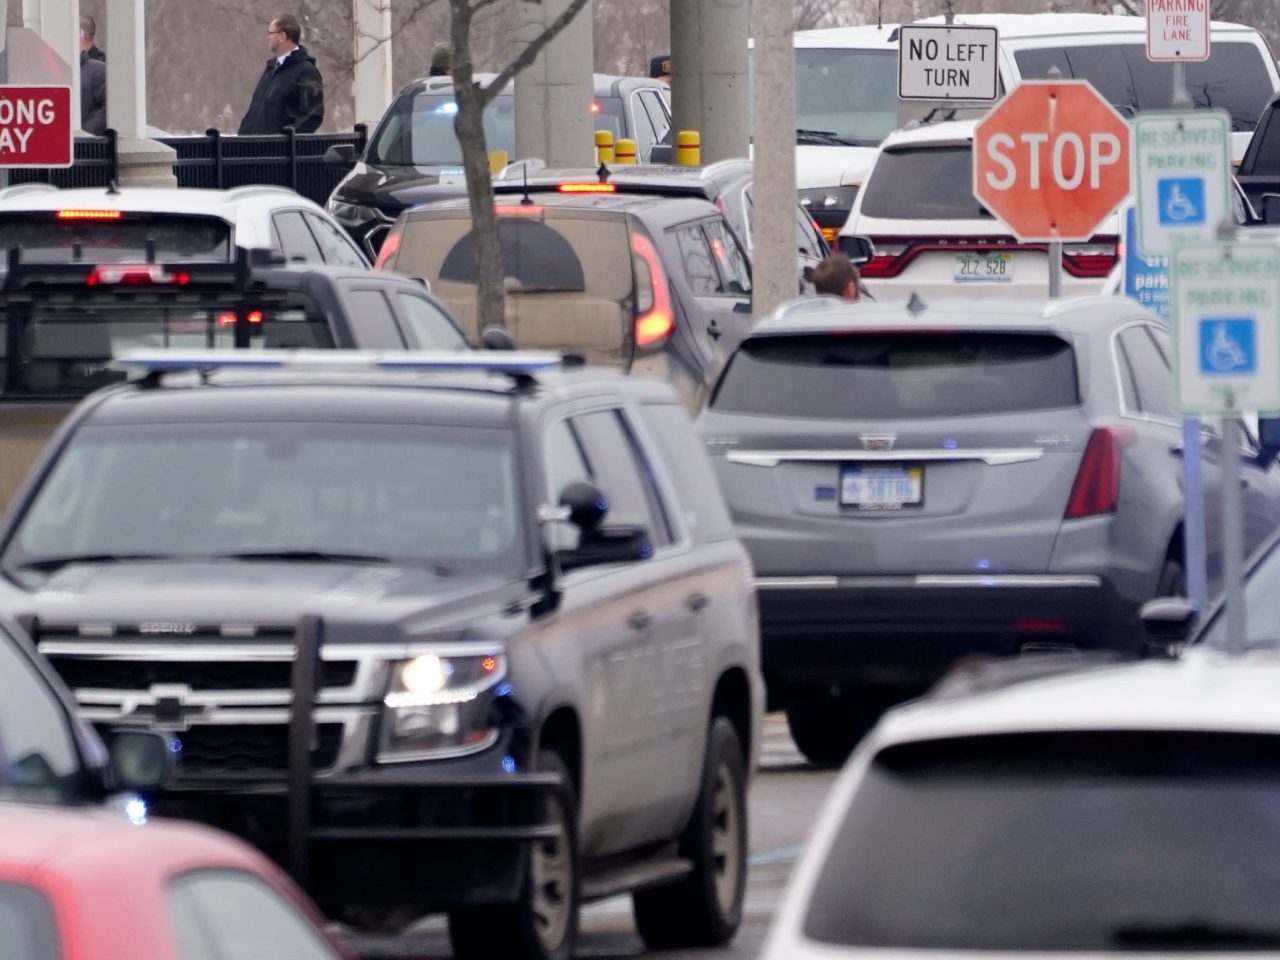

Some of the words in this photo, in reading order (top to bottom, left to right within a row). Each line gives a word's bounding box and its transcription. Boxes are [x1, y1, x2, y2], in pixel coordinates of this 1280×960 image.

[1166, 15, 1189, 27] FIRE
[1163, 29, 1192, 41] LANE
[909, 39, 938, 61] NO
[946, 43, 988, 61] LEFT
[924, 68, 970, 87] TURN
[985, 132, 1121, 191] STOP
